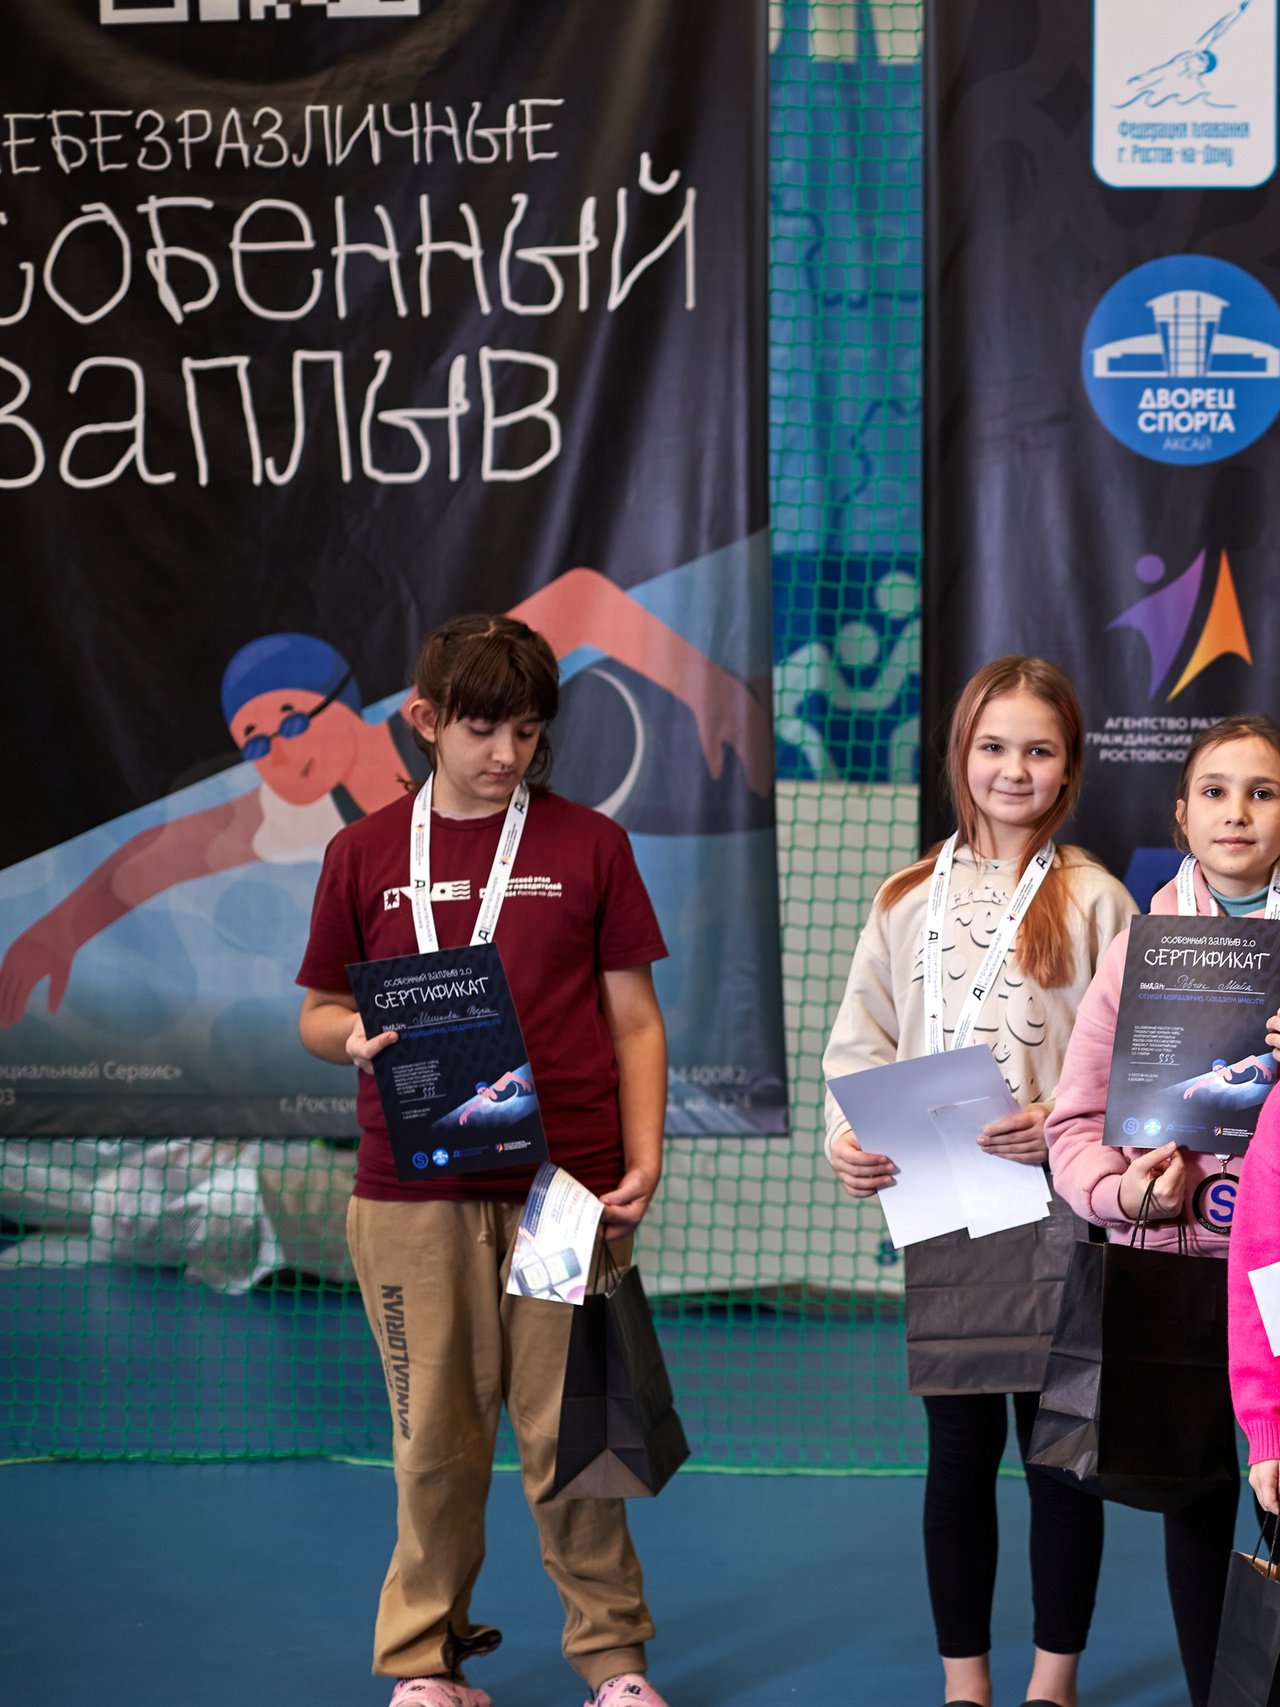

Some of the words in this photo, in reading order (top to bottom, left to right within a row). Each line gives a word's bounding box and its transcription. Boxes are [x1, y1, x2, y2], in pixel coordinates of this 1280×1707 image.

[0, 98, 565, 174] ЕБЕЗРАЗЛИЧНЫЕ
[1138, 388, 1236, 409] ДВОРЕЦ
[1137, 411, 1236, 433] СПОРТА
[1162, 435, 1212, 451] АКСАЙ
[1105, 717, 1188, 730] АГЕНТСТВО
[1085, 733, 1192, 746] ГРАЖДАНСКИХ
[1099, 749, 1187, 762] РОСТОВСКО
[1242, 939, 1256, 947] 2.0
[1144, 948, 1270, 970] СЕРТИФИКАТ
[460, 967, 472, 976] 2.0
[374, 976, 488, 1009] СЕРТИФИКАТ
[1209, 1184, 1237, 1223] S
